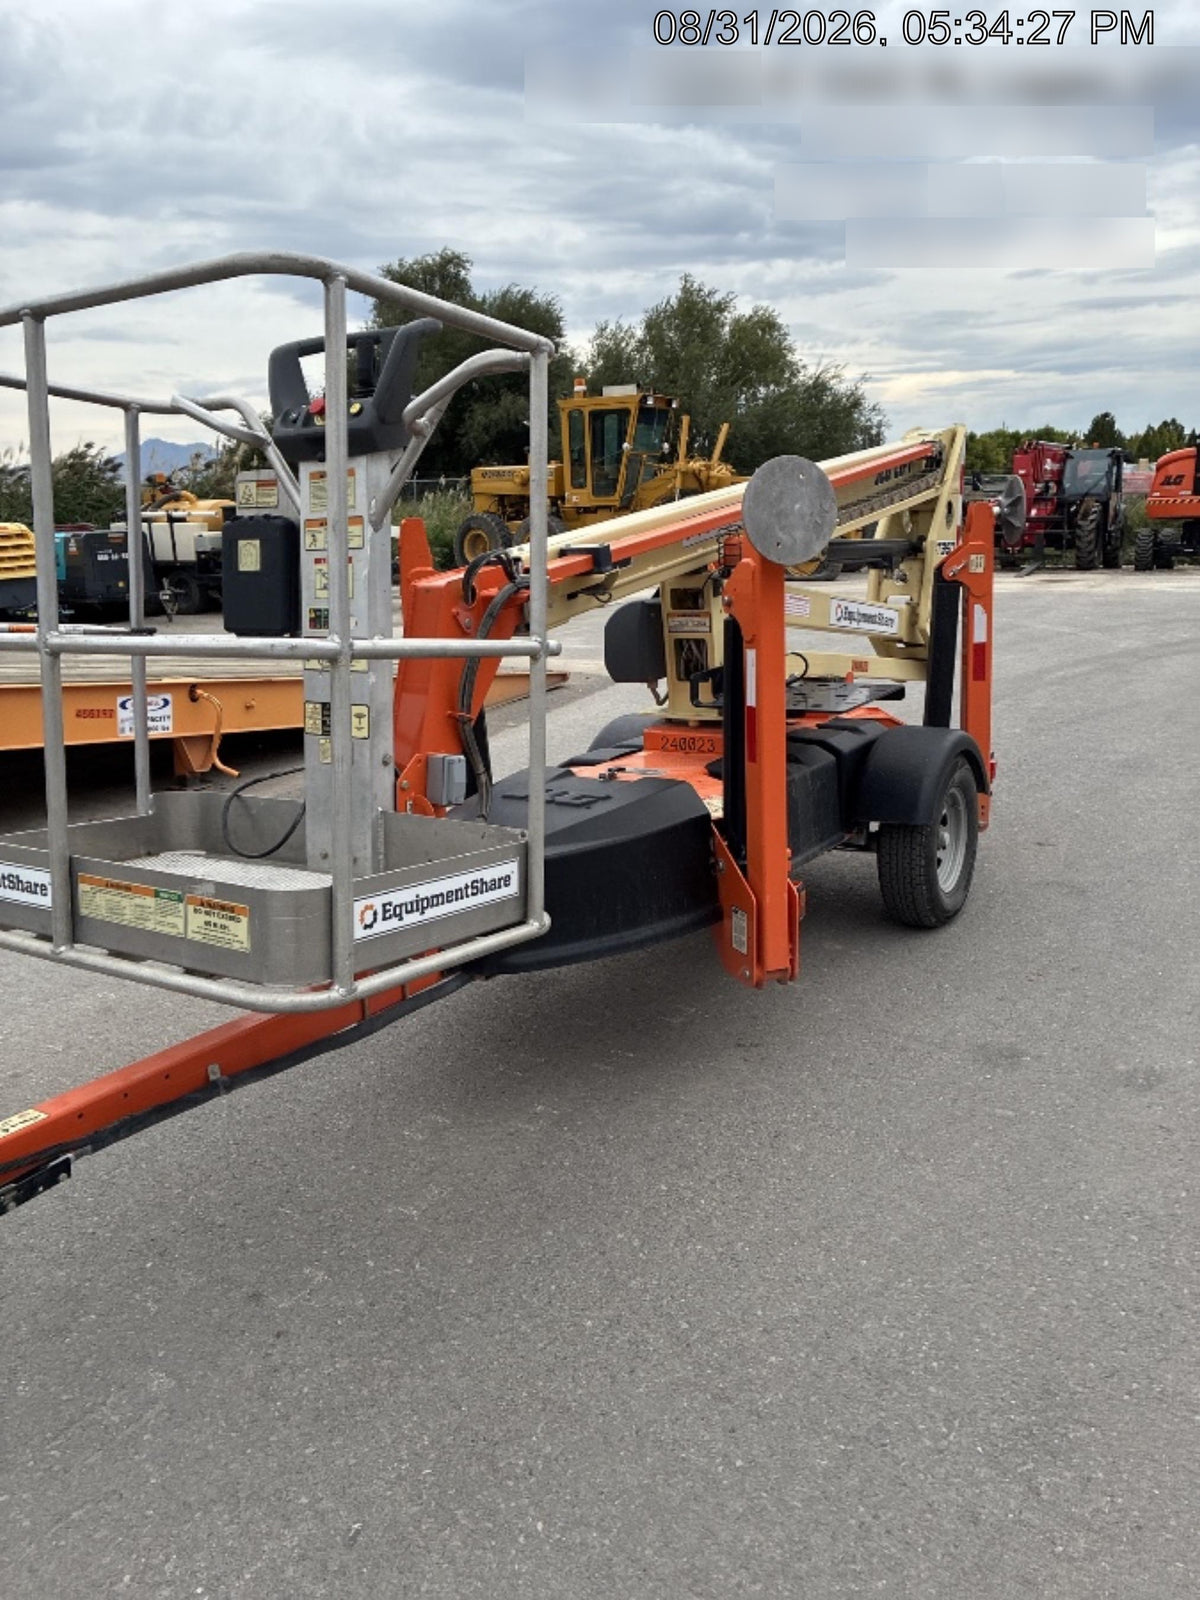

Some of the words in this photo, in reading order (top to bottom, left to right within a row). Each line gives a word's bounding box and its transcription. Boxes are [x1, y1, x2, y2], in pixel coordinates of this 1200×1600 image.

[1159, 474, 1186, 486] JLG
[661, 736, 716, 753] 240023
[0, 873, 48, 896] tShare
[382, 874, 511, 921] EquipmentShare
